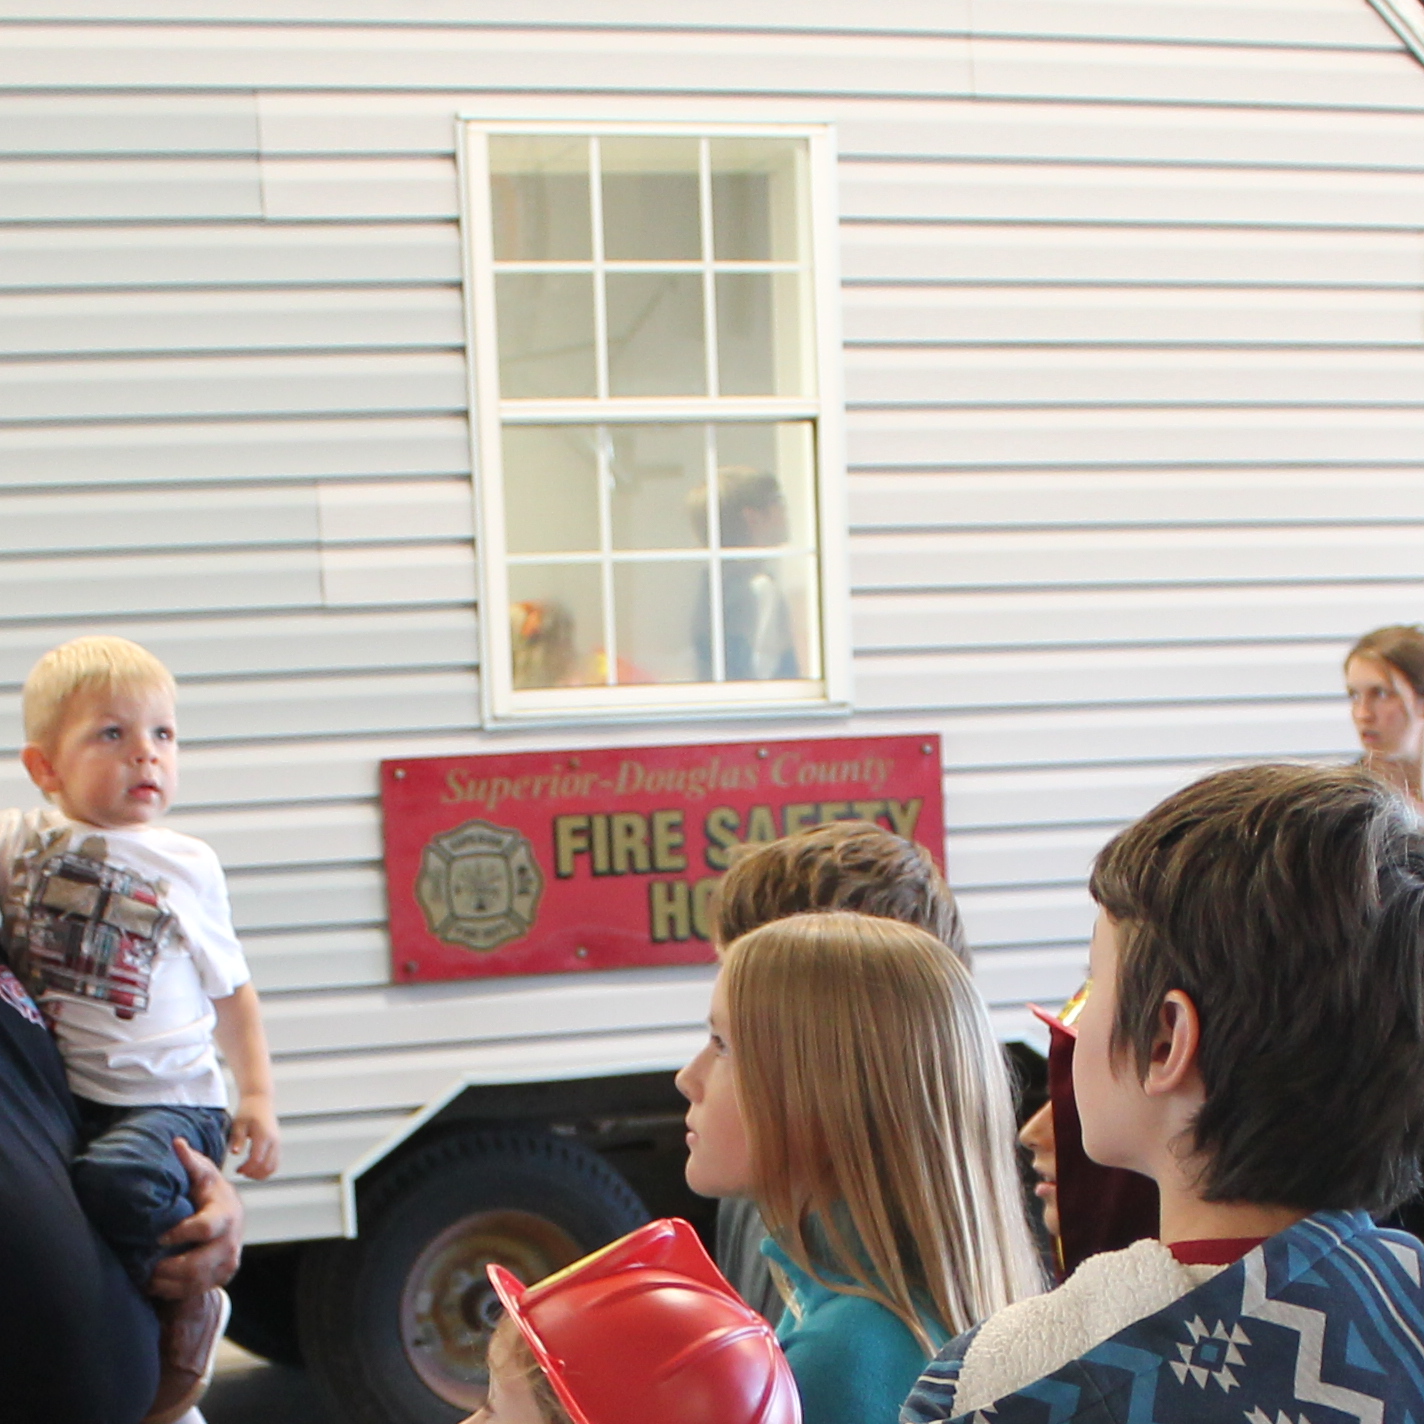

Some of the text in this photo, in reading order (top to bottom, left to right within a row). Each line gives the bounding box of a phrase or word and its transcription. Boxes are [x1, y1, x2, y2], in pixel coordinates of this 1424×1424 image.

[442, 751, 895, 811] Superior-Douglas County
[555, 810, 687, 877] FIRE
